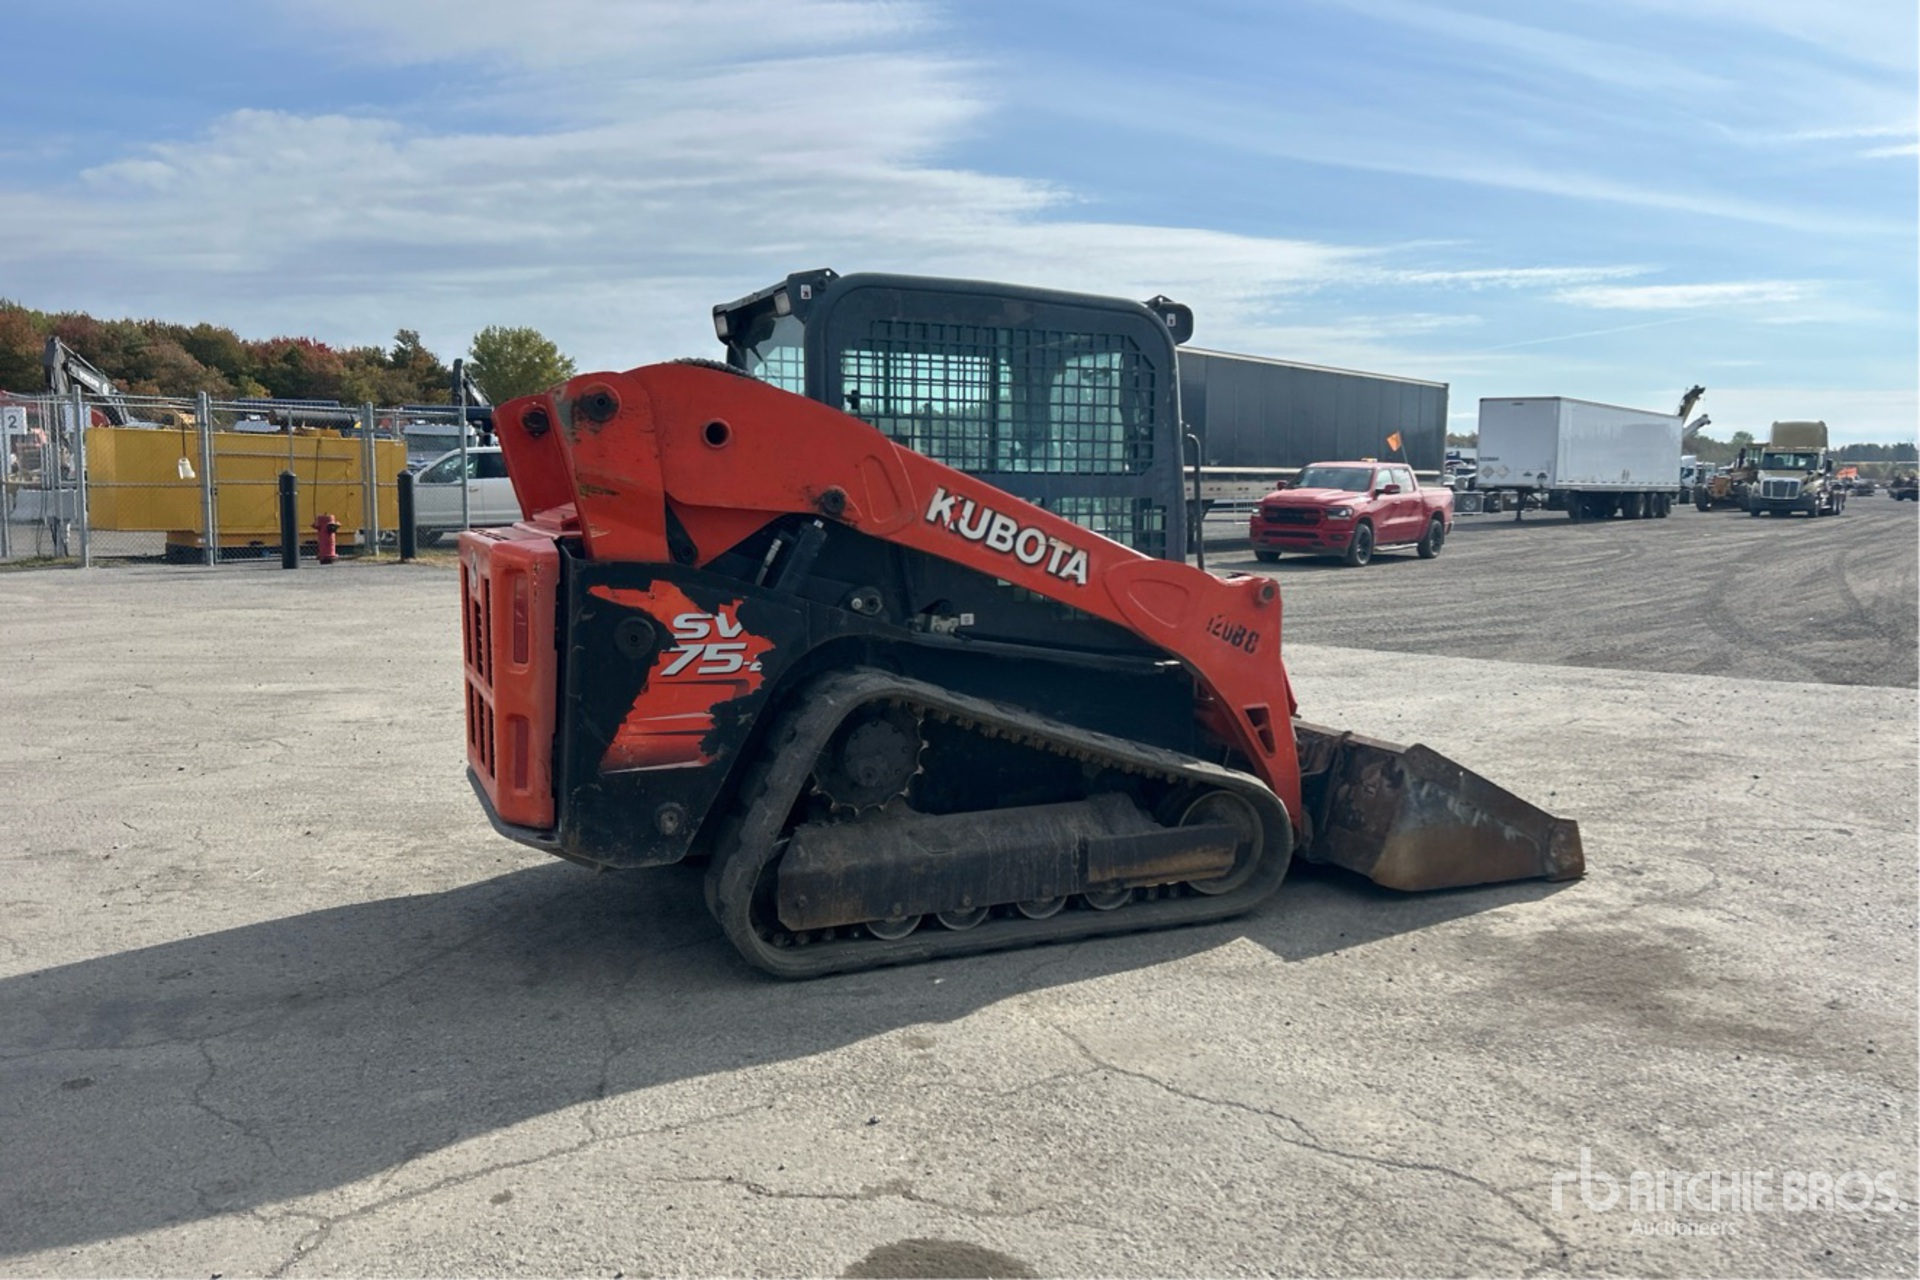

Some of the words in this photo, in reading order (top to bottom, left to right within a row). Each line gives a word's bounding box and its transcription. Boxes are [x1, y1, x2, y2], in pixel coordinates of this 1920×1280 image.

[8, 414, 18, 429] 2
[926, 486, 1088, 585] KUBOTA
[673, 612, 743, 639] SV
